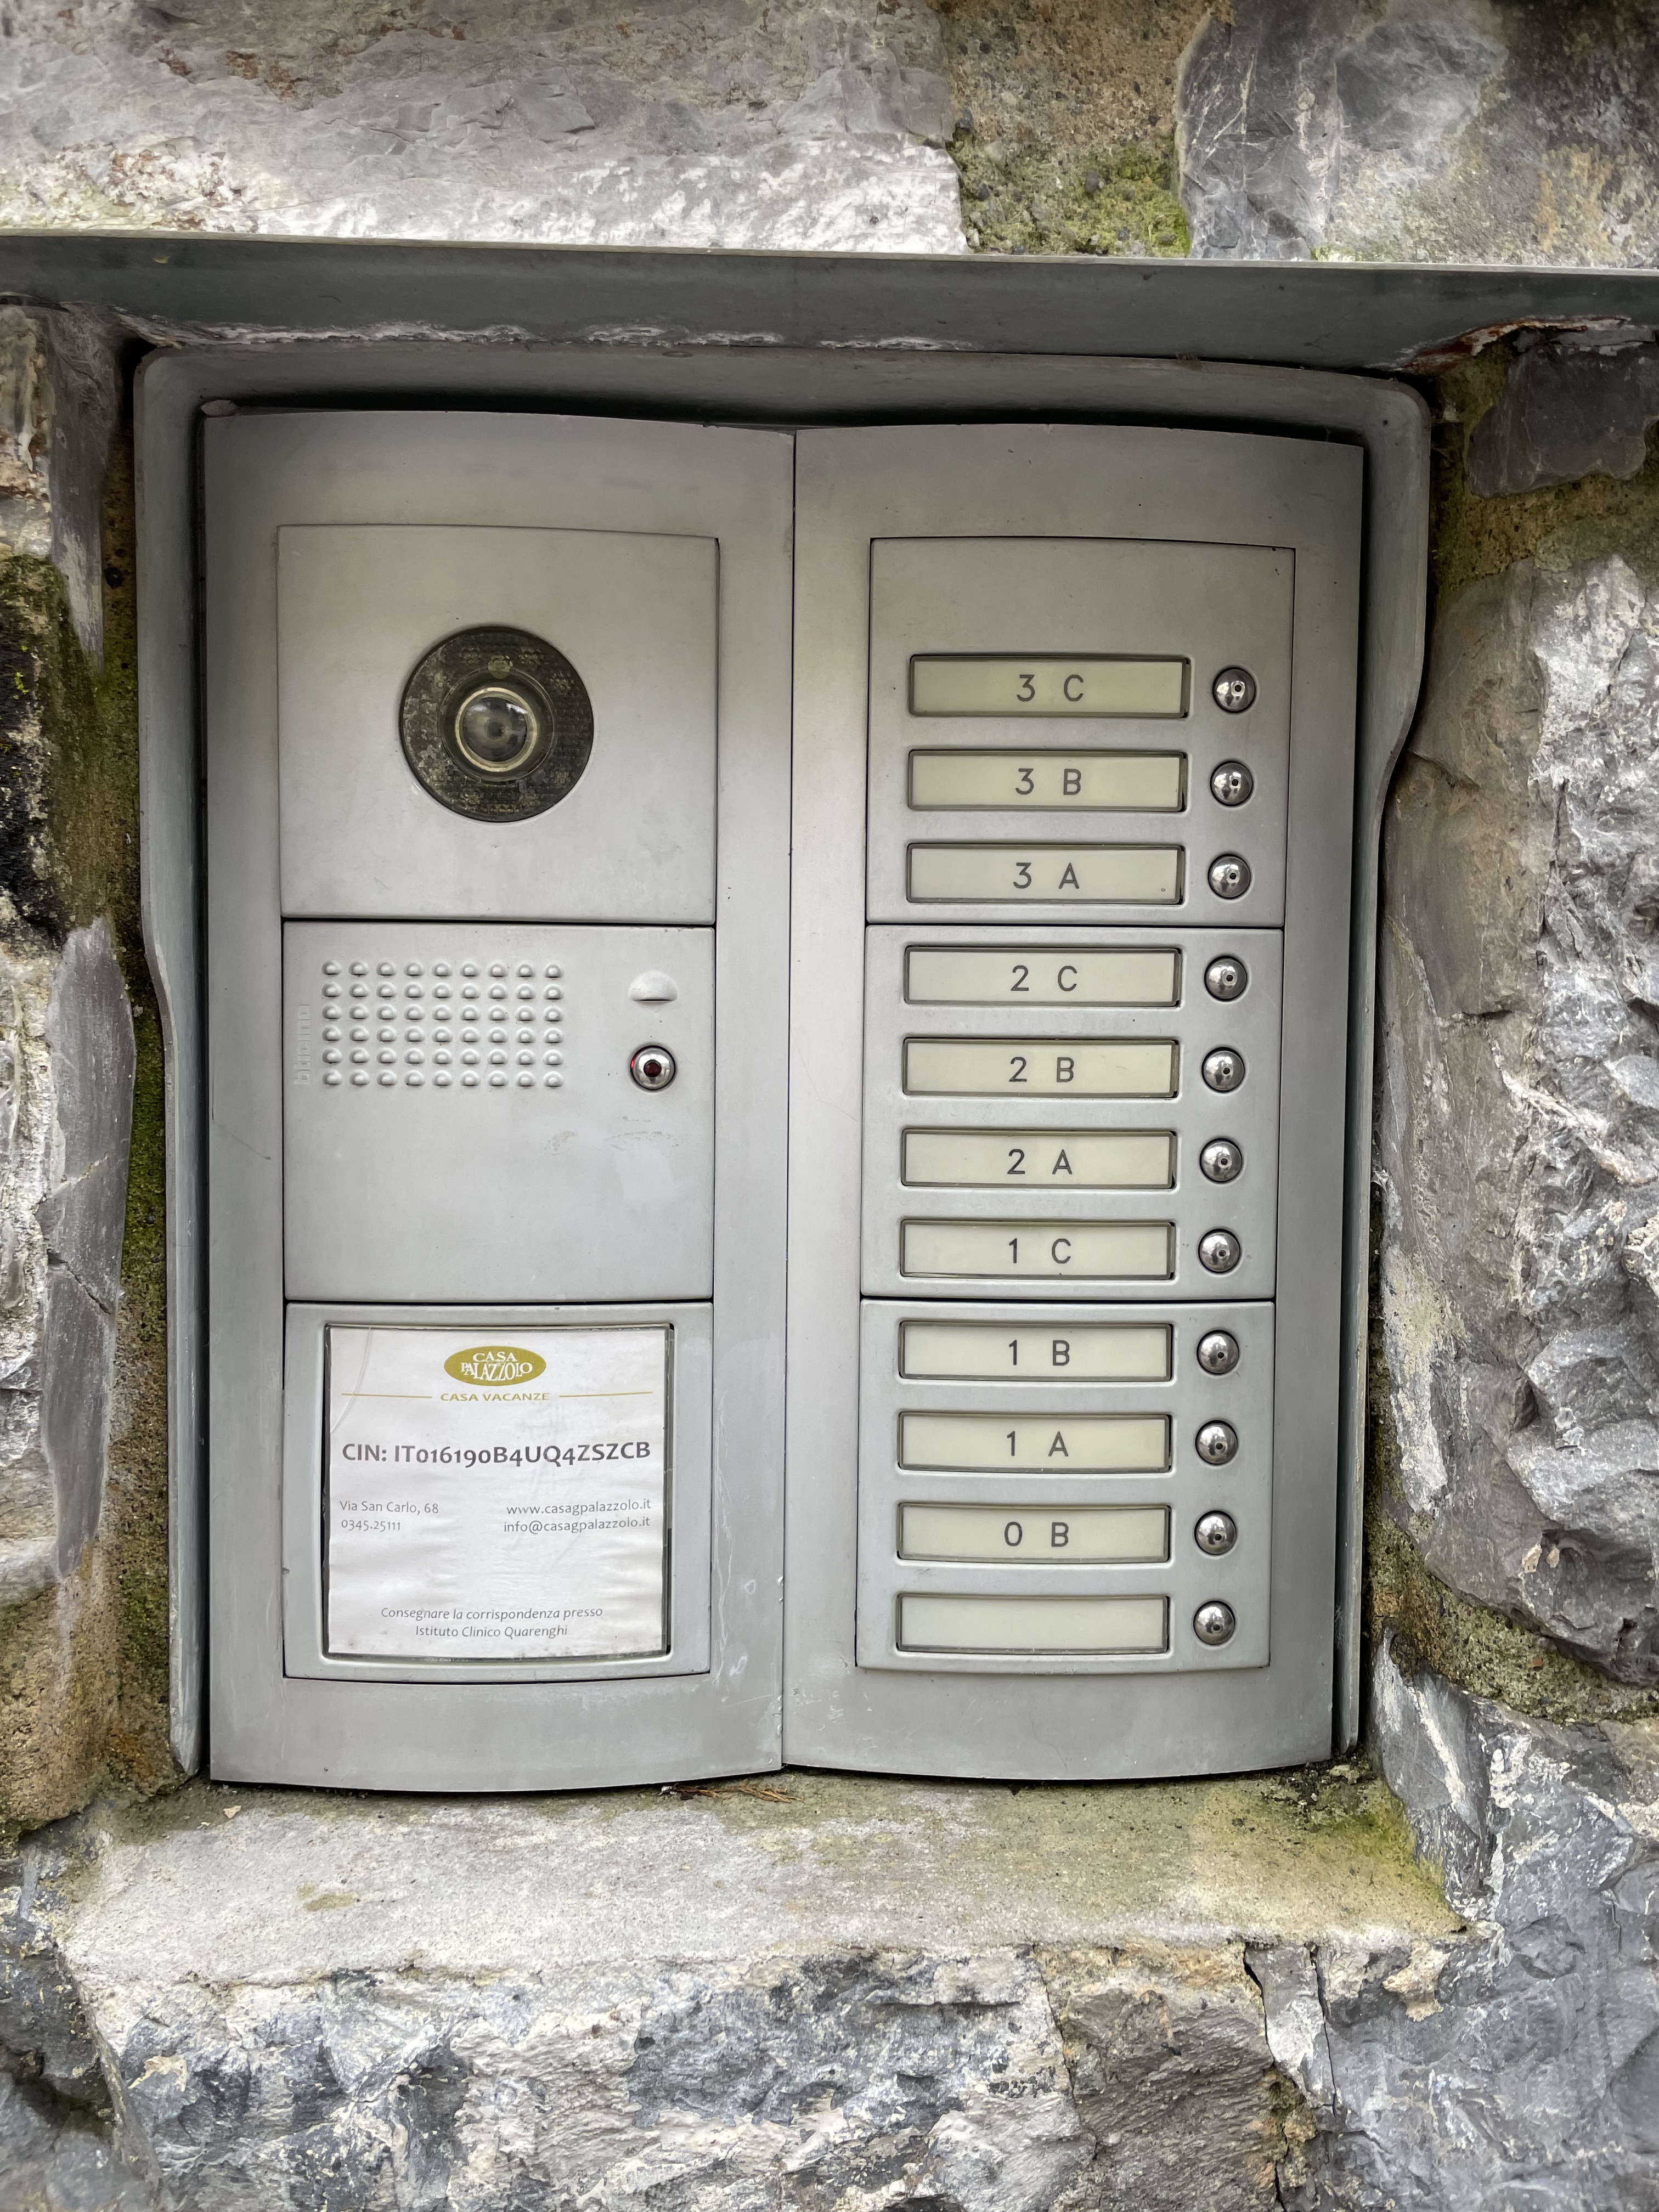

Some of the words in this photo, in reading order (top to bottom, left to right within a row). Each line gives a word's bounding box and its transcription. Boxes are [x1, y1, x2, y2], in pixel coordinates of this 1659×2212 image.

[1016, 674, 1036, 702] 3
[1063, 674, 1084, 702] C
[1015, 768, 1035, 795] 3
[1063, 768, 1082, 795] B
[1013, 862, 1032, 889] 3
[1058, 862, 1080, 889] A
[1010, 964, 1030, 992] 2
[1057, 965, 1078, 992] C
[1008, 1056, 1028, 1083] 2
[1056, 1057, 1075, 1083] B
[1006, 1148, 1026, 1175] 2
[1052, 1149, 1073, 1175] A
[1008, 1237, 1018, 1264] 1
[1051, 1238, 1071, 1265] C
[472, 1351, 518, 1362] CASA
[1008, 1339, 1018, 1366] 1
[1052, 1340, 1070, 1367] B
[461, 1362, 533, 1381] PALAZZOLO
[440, 1393, 478, 1402] CASA
[482, 1392, 550, 1401] VACANZE
[342, 1443, 387, 1462] CIN:
[394, 1441, 651, 1468] IT016190B4UQ4ZSZCB
[1006, 1430, 1015, 1457] 1
[1048, 1431, 1069, 1457] A
[340, 1500, 357, 1511] Via
[361, 1500, 382, 1512] San
[386, 1502, 420, 1516] Carlo,
[424, 1503, 439, 1514] 68
[506, 1498, 651, 1516] www.casagpalazzolo.it
[341, 1519, 400, 1532] 0345.25111
[504, 1516, 651, 1534] info@casagpalazzolo.it
[1004, 1521, 1023, 1547] 0
[1051, 1522, 1069, 1548] B
[381, 1607, 450, 1621] Consegnare
[453, 1608, 463, 1620] la
[466, 1607, 560, 1622] corrispondenza
[563, 1608, 603, 1621] presso
[415, 1625, 459, 1637] Istituto
[461, 1626, 501, 1638] Clinico
[504, 1624, 568, 1640] Quarenghi
